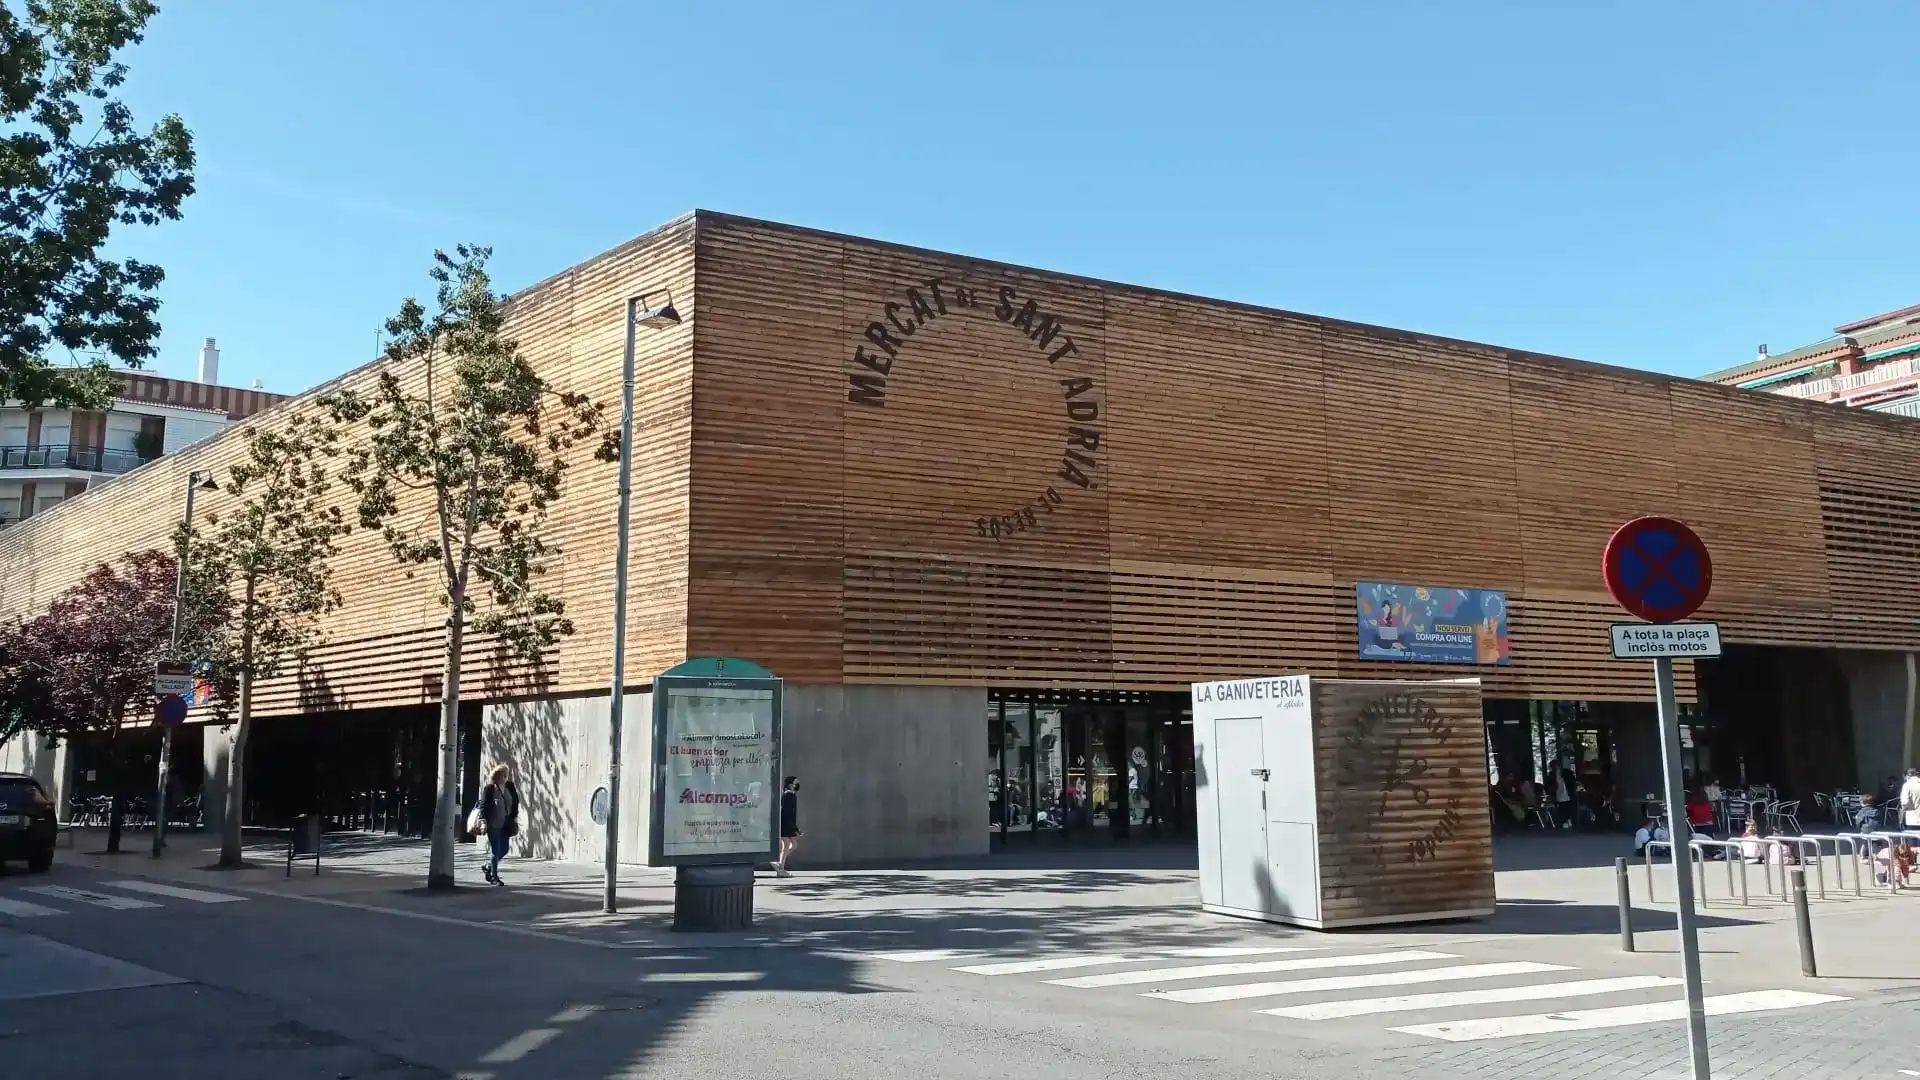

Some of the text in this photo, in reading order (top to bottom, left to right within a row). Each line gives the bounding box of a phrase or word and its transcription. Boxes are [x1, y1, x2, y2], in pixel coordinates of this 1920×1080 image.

[848, 279, 947, 407] MERCAT
[995, 285, 1078, 364] SANT
[1415, 633, 1445, 642] COMPRA
[1446, 634, 1457, 642] ON
[1623, 628, 1710, 641] A tota la plaça
[1628, 641, 1708, 653] inclòs motos
[1197, 679, 1304, 702] LA GANIVETERIA
[670, 746, 729, 757] El buen sabor
[690, 757, 731, 774] empieza
[732, 757, 744, 768] por
[679, 788, 748, 807] Alcampo
